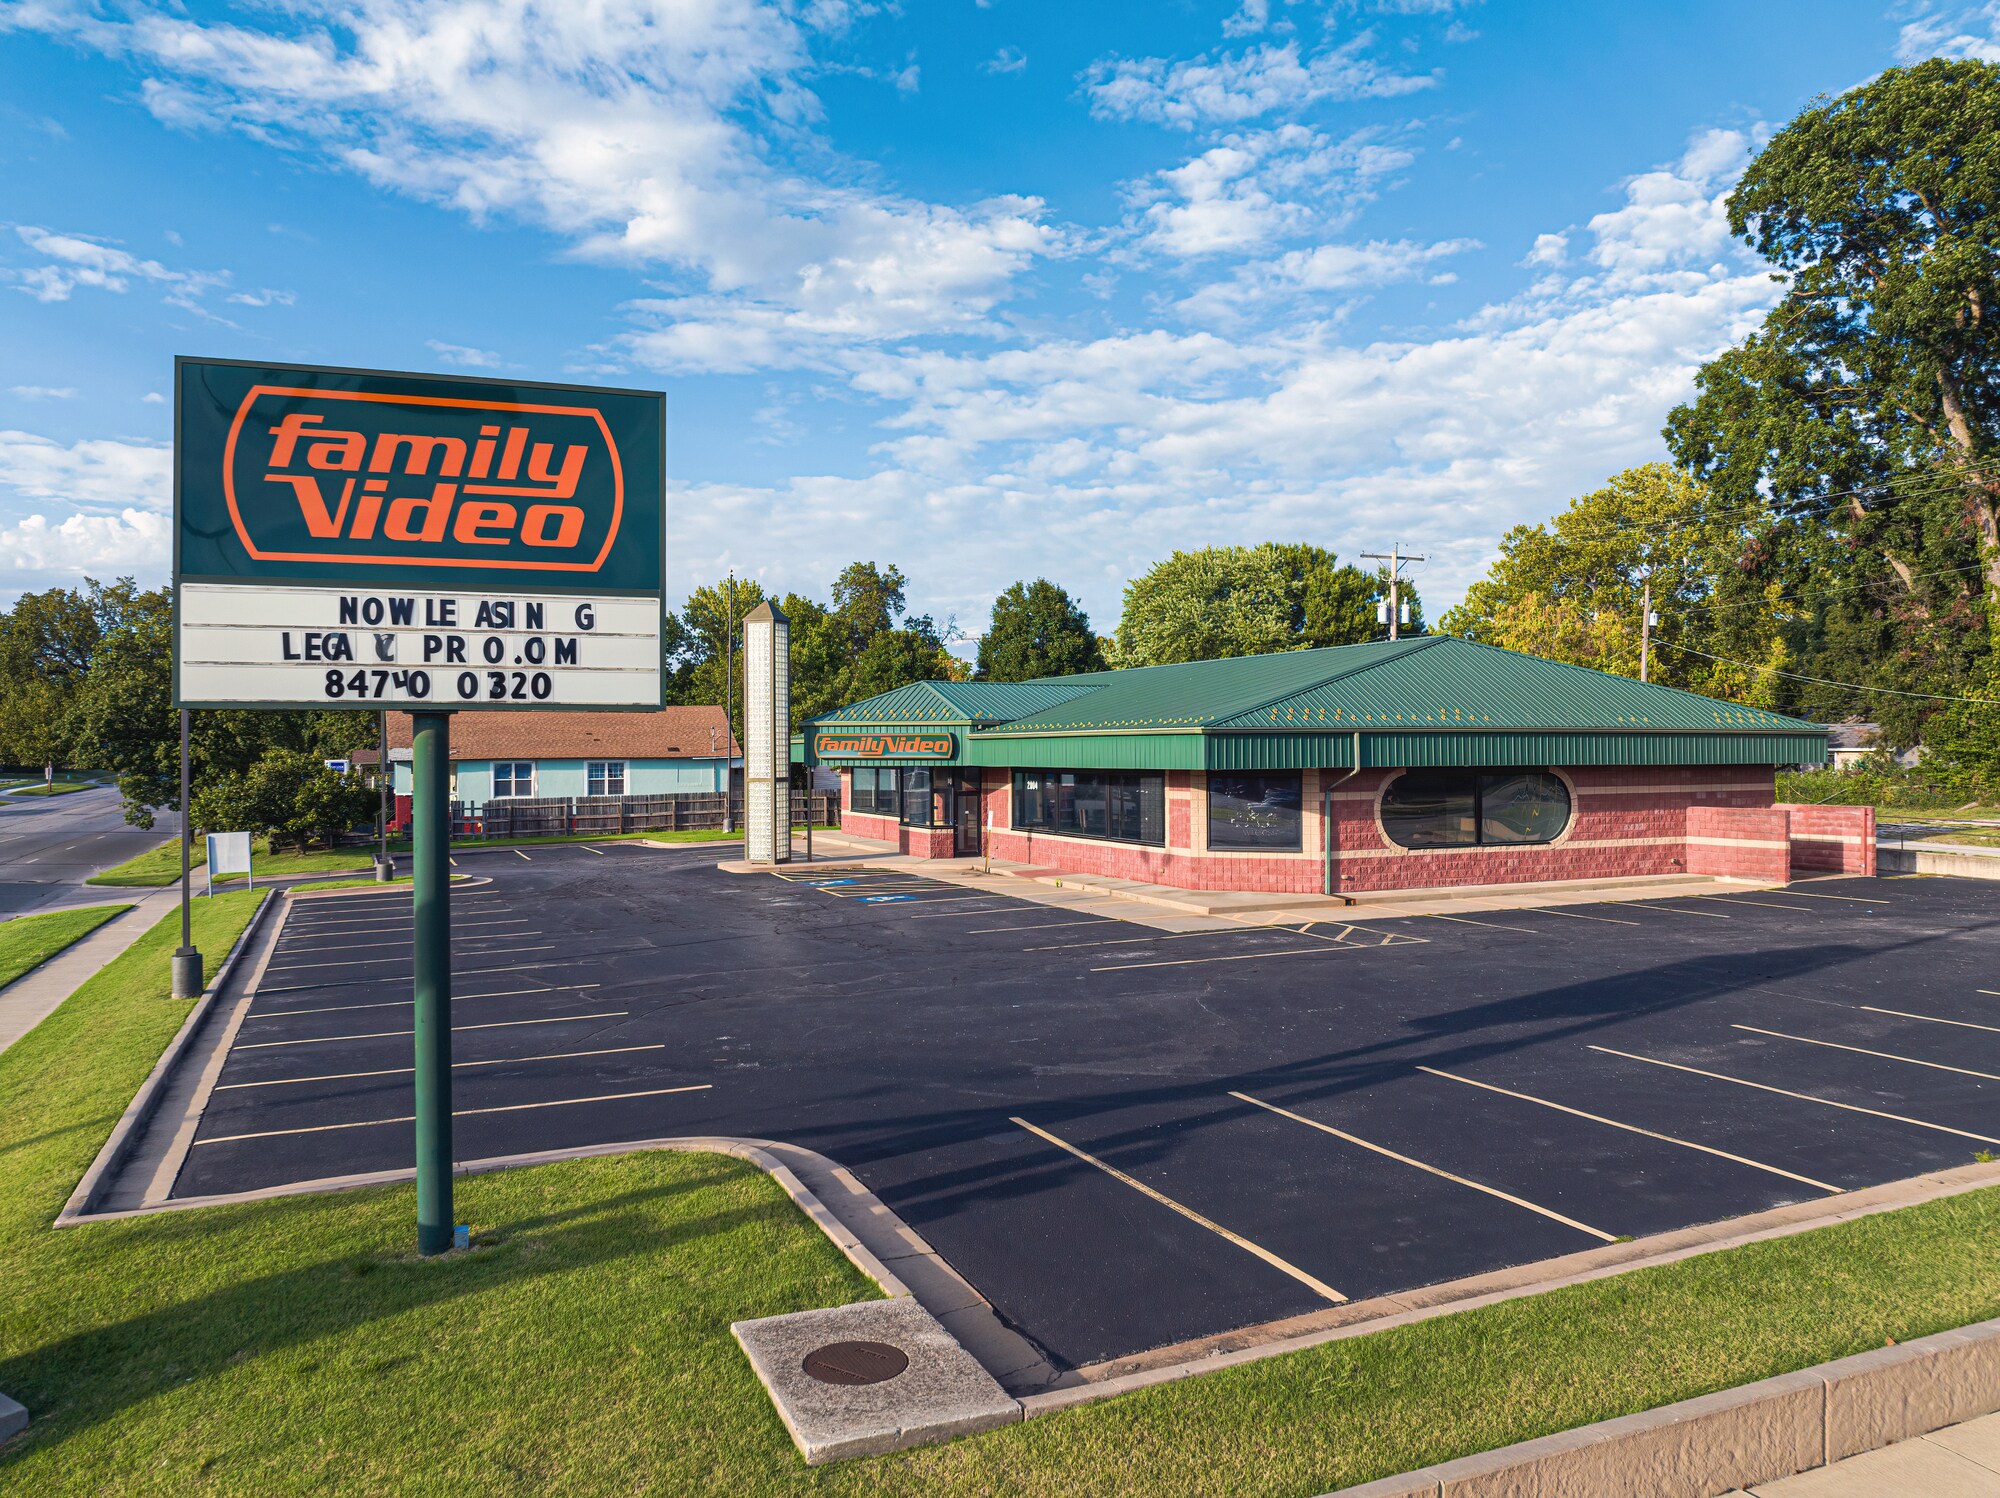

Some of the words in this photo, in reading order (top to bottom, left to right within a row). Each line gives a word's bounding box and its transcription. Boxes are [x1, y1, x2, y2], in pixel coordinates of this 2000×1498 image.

[268, 413, 588, 498] family
[263, 473, 585, 548] Video
[340, 596, 415, 626] NOW
